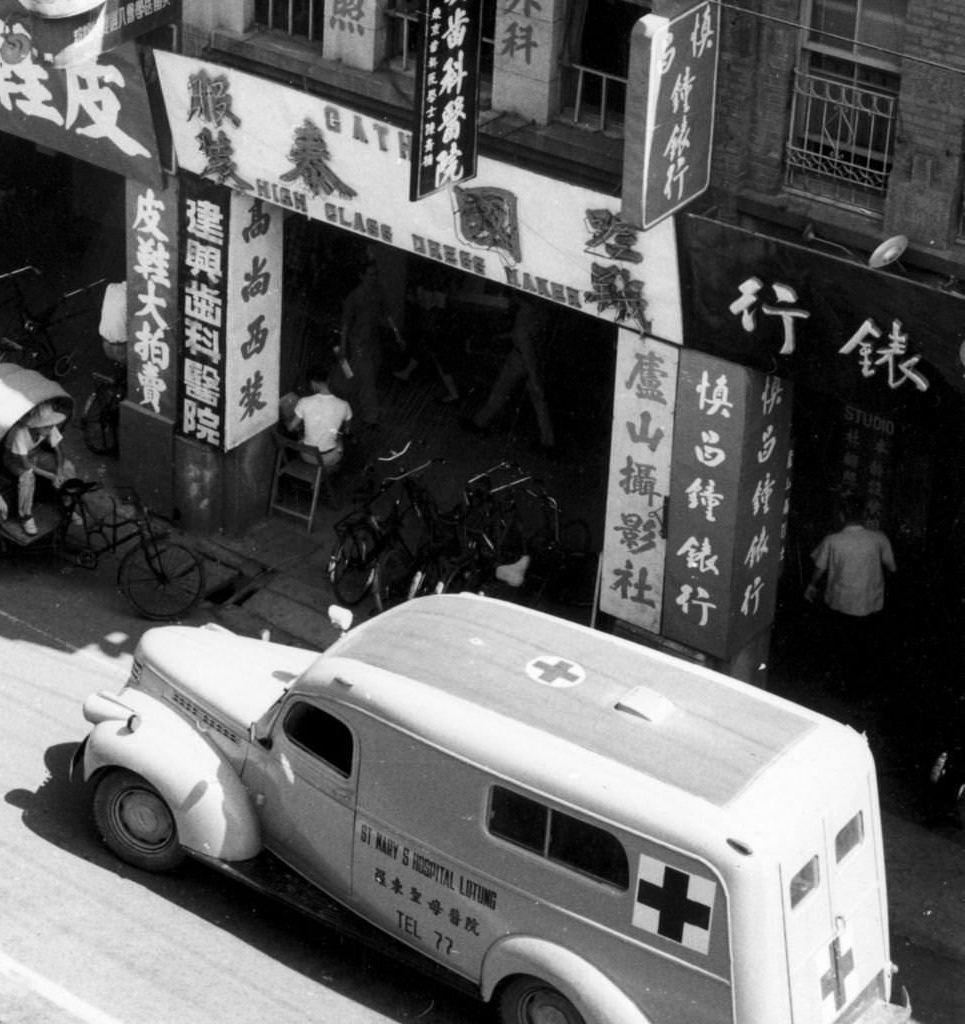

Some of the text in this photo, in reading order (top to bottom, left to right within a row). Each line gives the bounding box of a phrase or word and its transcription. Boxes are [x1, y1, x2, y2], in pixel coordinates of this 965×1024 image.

[256, 178, 310, 213] HIGH
[324, 202, 394, 244] CLASS
[411, 233, 486, 276] DRESS
[132, 187, 172, 414] 皮鞋大拍賣
[360, 823, 373, 846] ST
[411, 852, 455, 890] HOSPITAL
[459, 875, 498, 910] LOTUNG
[396, 910, 454, 955] TEL 77
